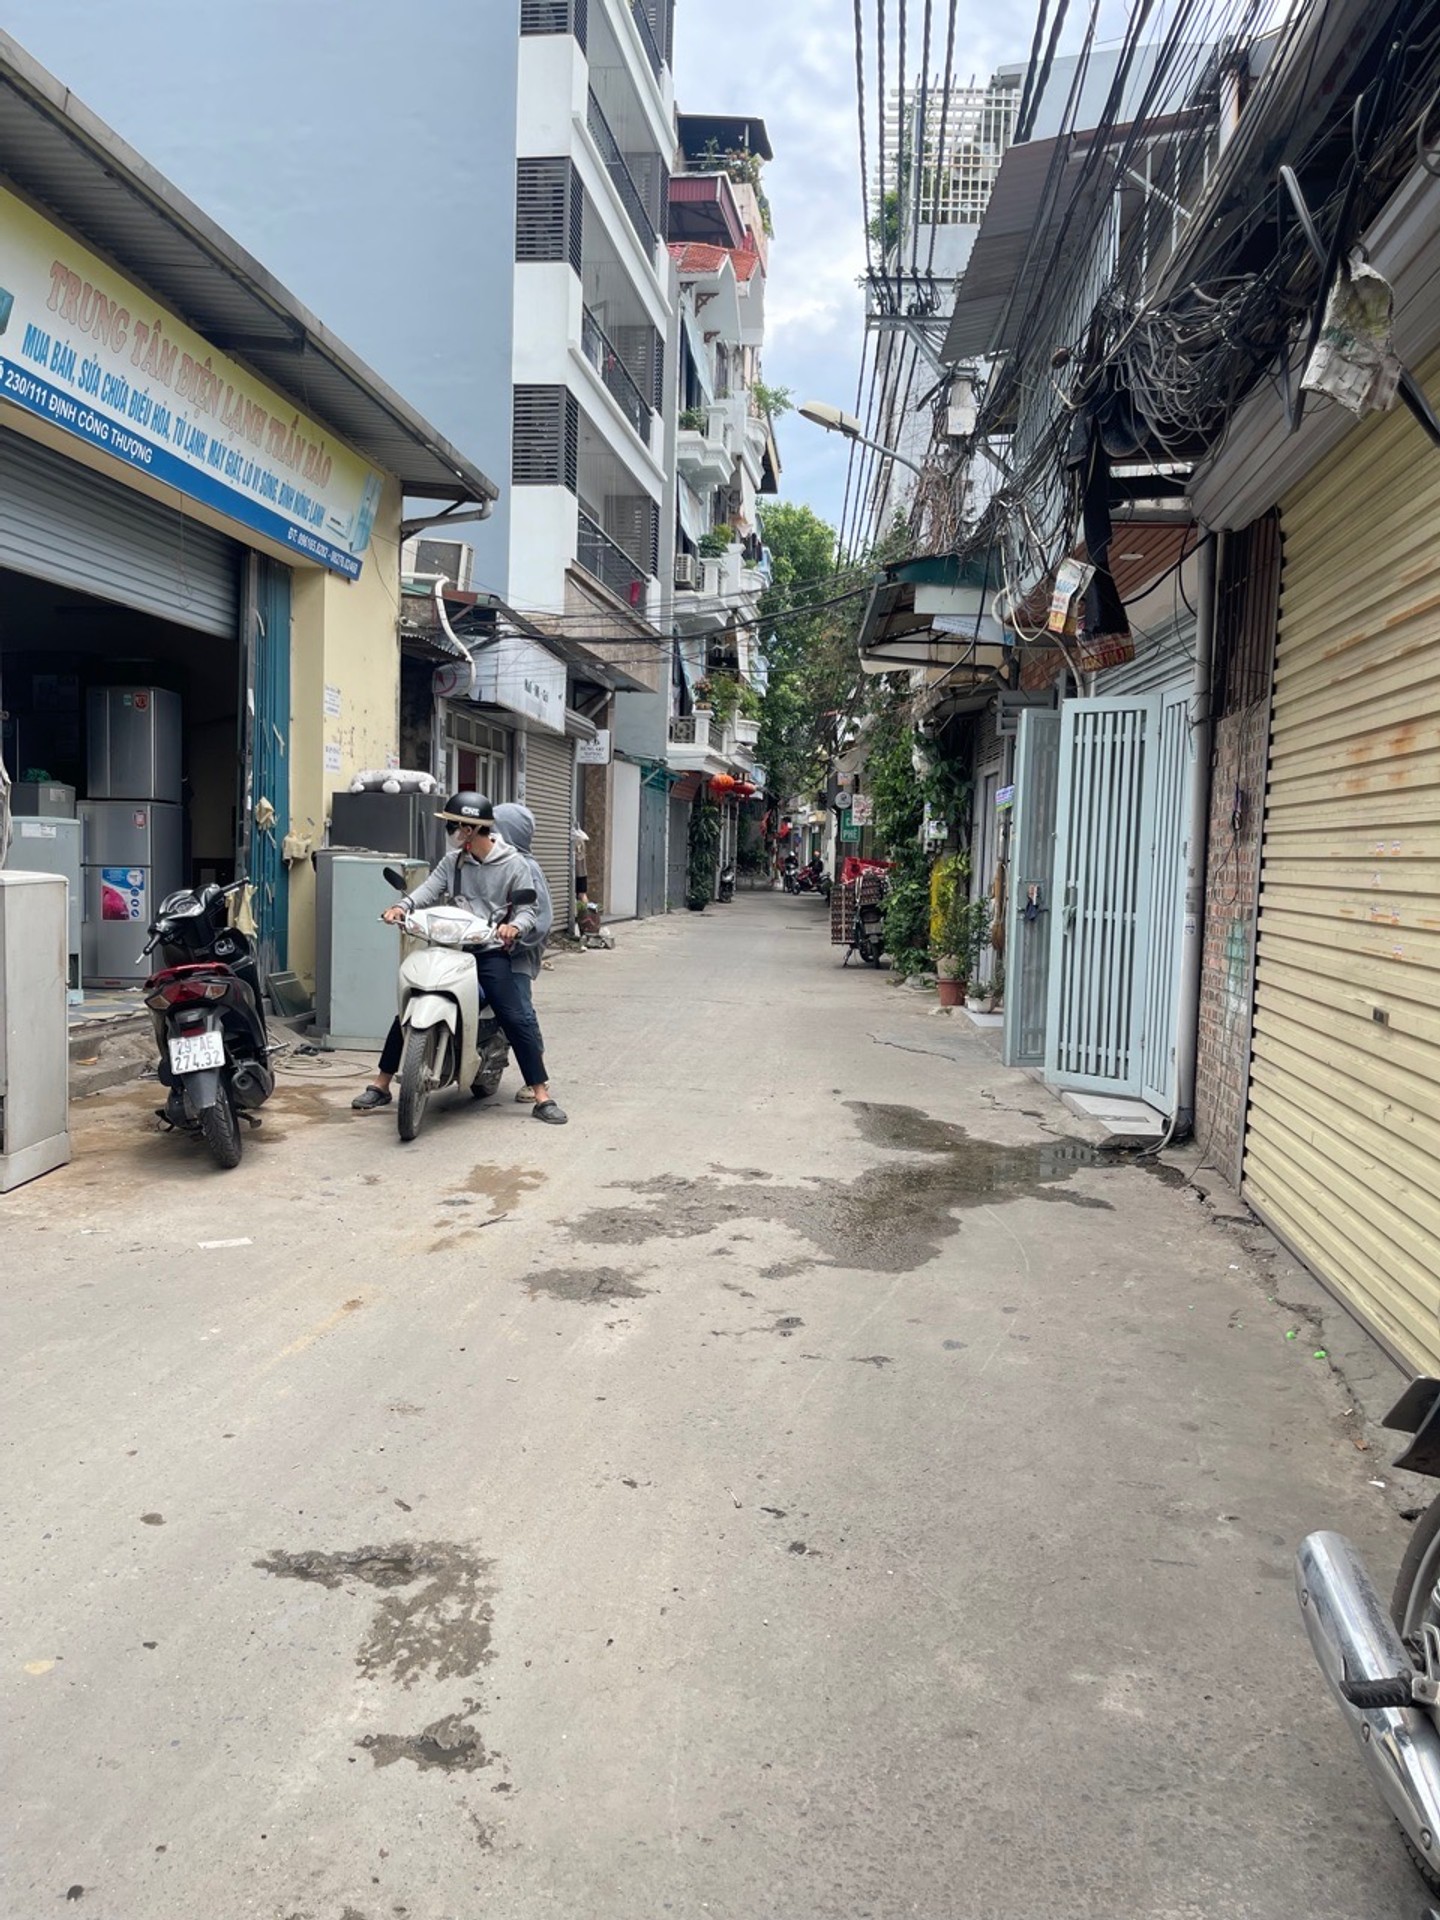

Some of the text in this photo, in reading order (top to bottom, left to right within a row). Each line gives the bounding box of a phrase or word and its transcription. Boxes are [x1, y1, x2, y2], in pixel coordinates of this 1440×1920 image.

[22, 323, 51, 367] MUA
[50, 340, 77, 387] BÁN,
[78, 353, 101, 397] SỬA
[100, 373, 129, 414] CHỮA
[172, 411, 187, 446] TỦ
[207, 438, 227, 471] MÁY
[47, 260, 130, 353] TRUNG
[131, 319, 178, 387] TÂM
[174, 356, 224, 418] ĐIỆN
[220, 385, 268, 448] LẠNH
[5, 370, 47, 406] 230/111
[48, 393, 78, 423] ĐỊNH
[77, 411, 110, 440] CÔNG
[111, 428, 153, 464] THƯỢNG
[175, 1050, 221, 1071] 274.32
